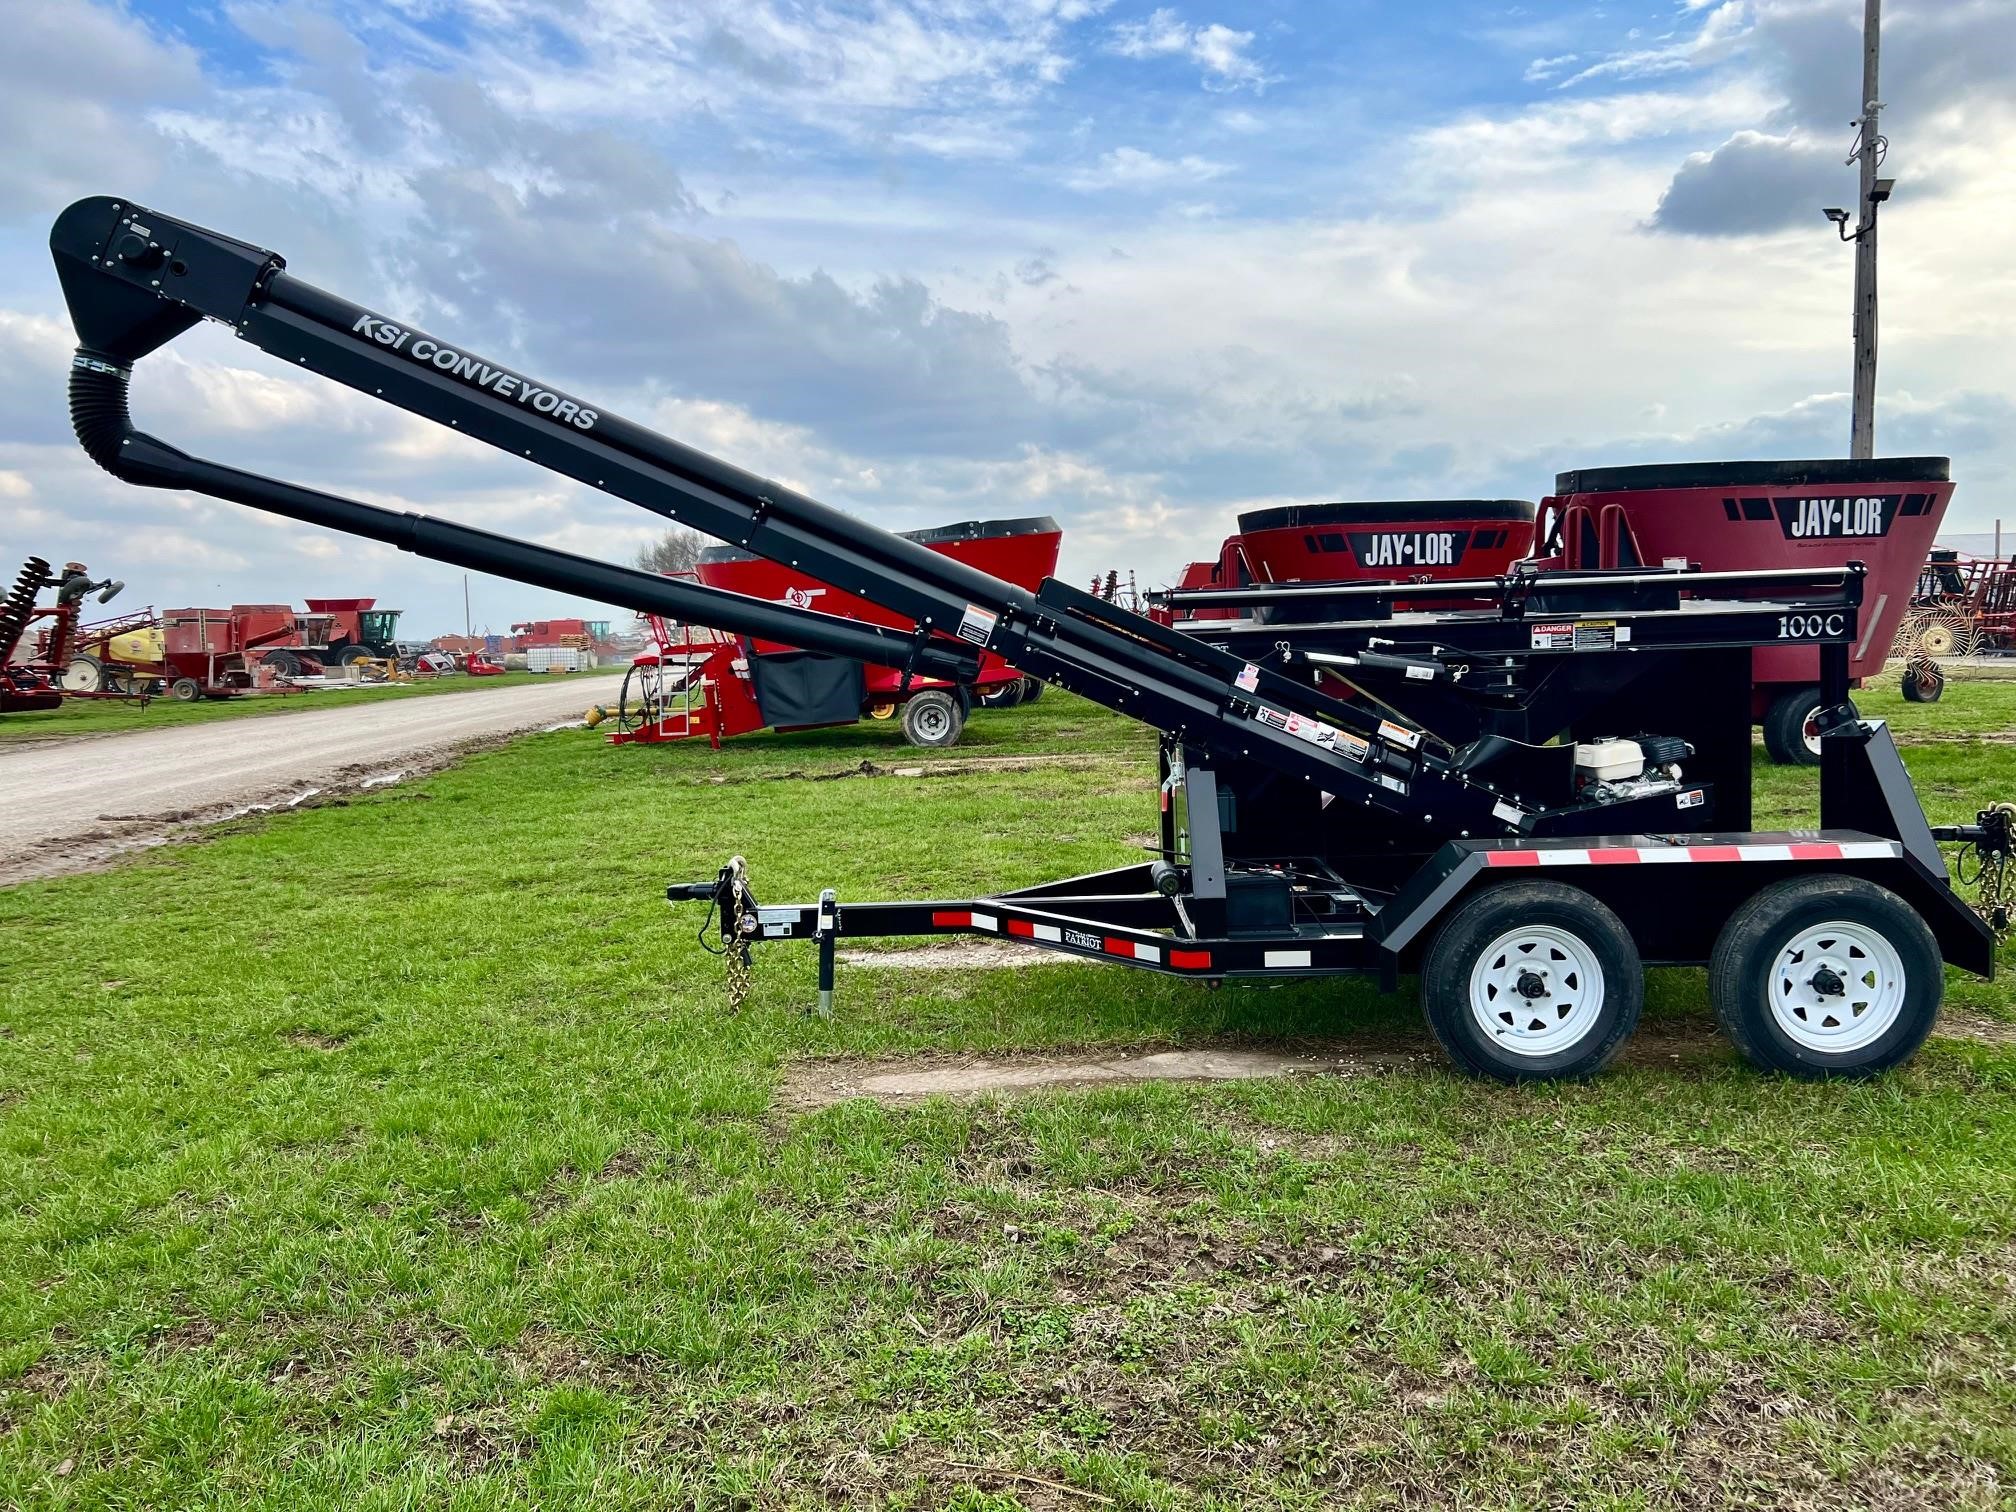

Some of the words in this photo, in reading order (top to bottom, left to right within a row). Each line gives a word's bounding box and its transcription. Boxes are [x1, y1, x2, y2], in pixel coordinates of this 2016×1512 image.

[411, 340, 599, 430] CONVEYORS
[1541, 625, 1572, 633] DANGER
[1065, 931, 1102, 950] PATRIOT
